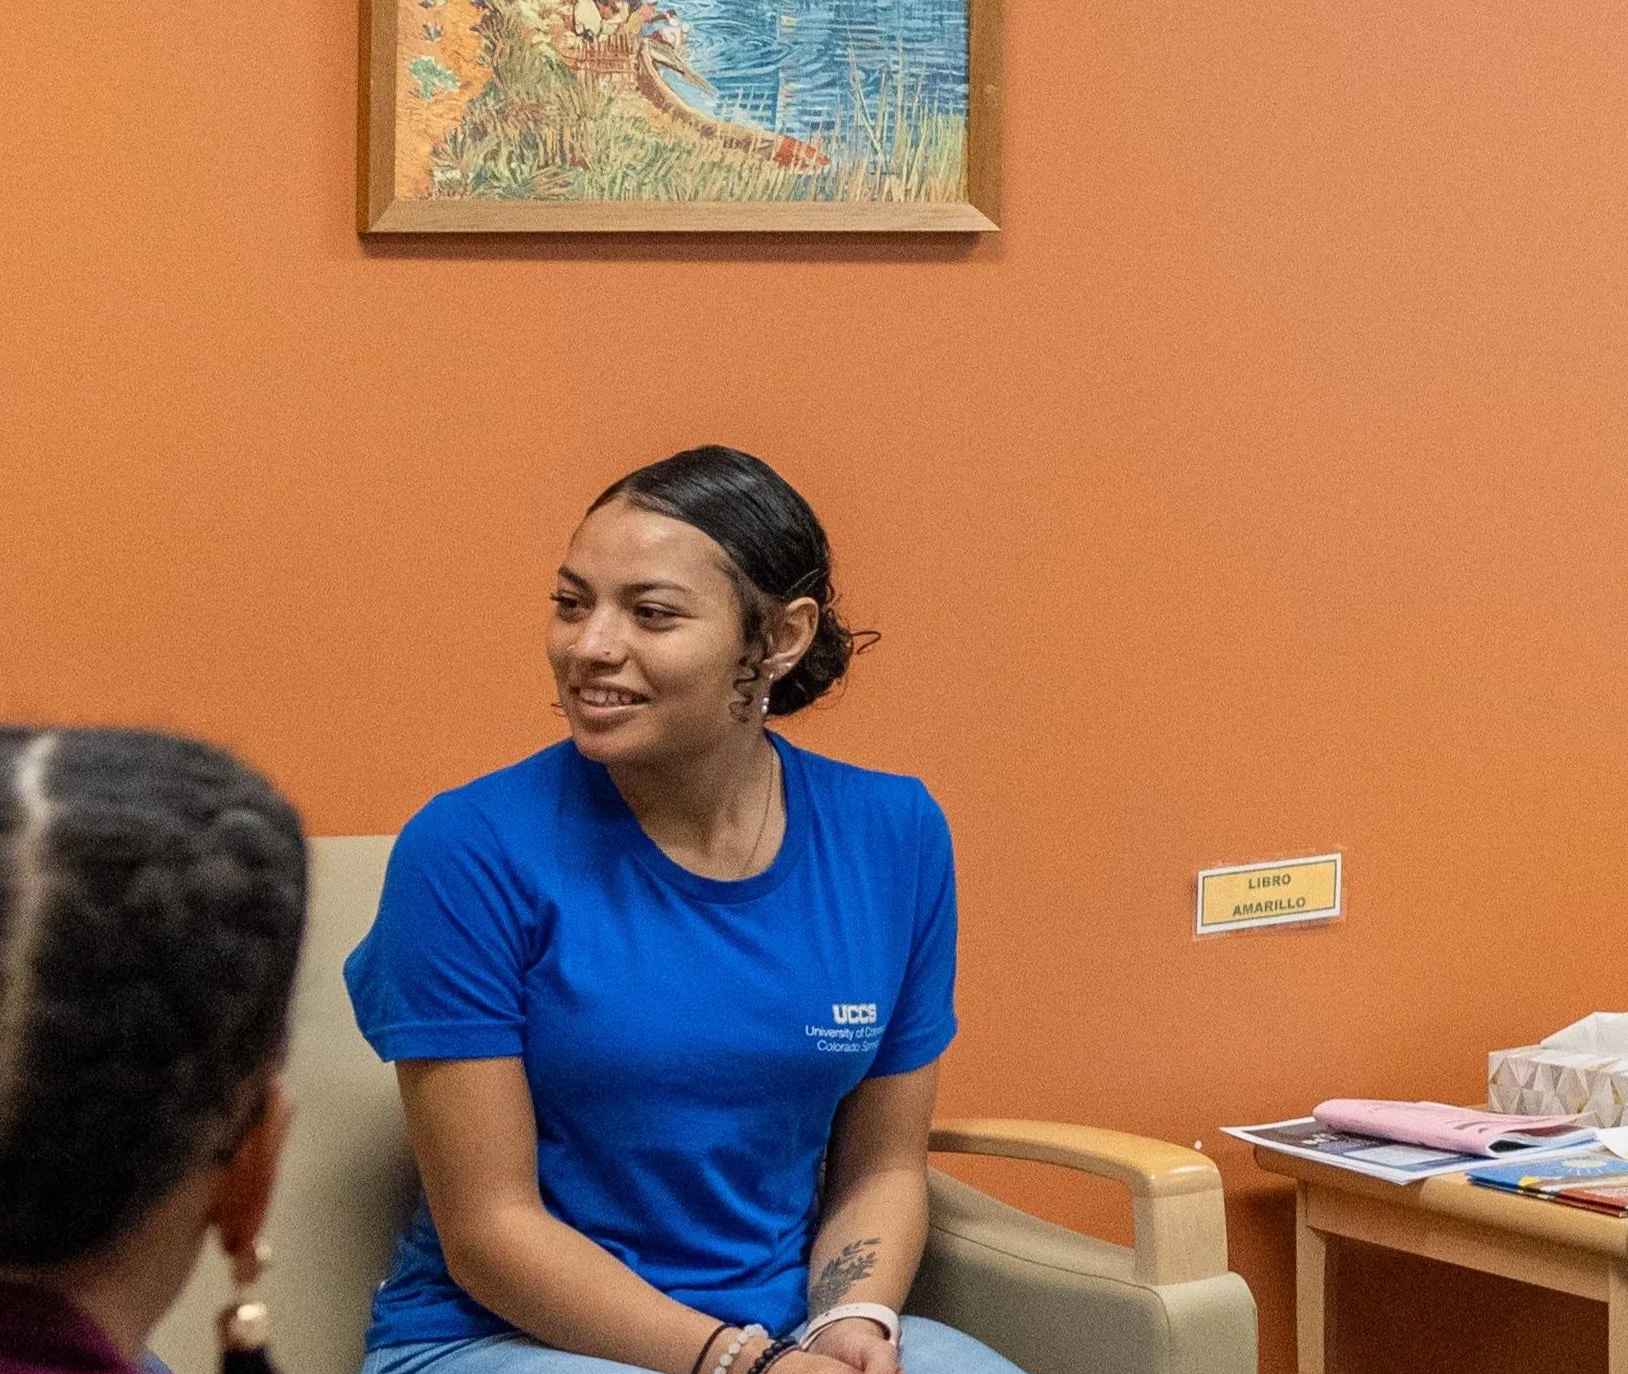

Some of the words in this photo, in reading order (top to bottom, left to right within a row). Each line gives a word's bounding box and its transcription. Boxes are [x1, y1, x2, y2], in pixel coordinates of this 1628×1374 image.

[1248, 873, 1292, 889] LIBRO
[1232, 897, 1306, 917] AMARILLO
[832, 1002, 877, 1024] UCCS
[805, 1025, 854, 1040] University
[855, 1027, 864, 1037] of
[817, 1040, 861, 1052] Colorado
